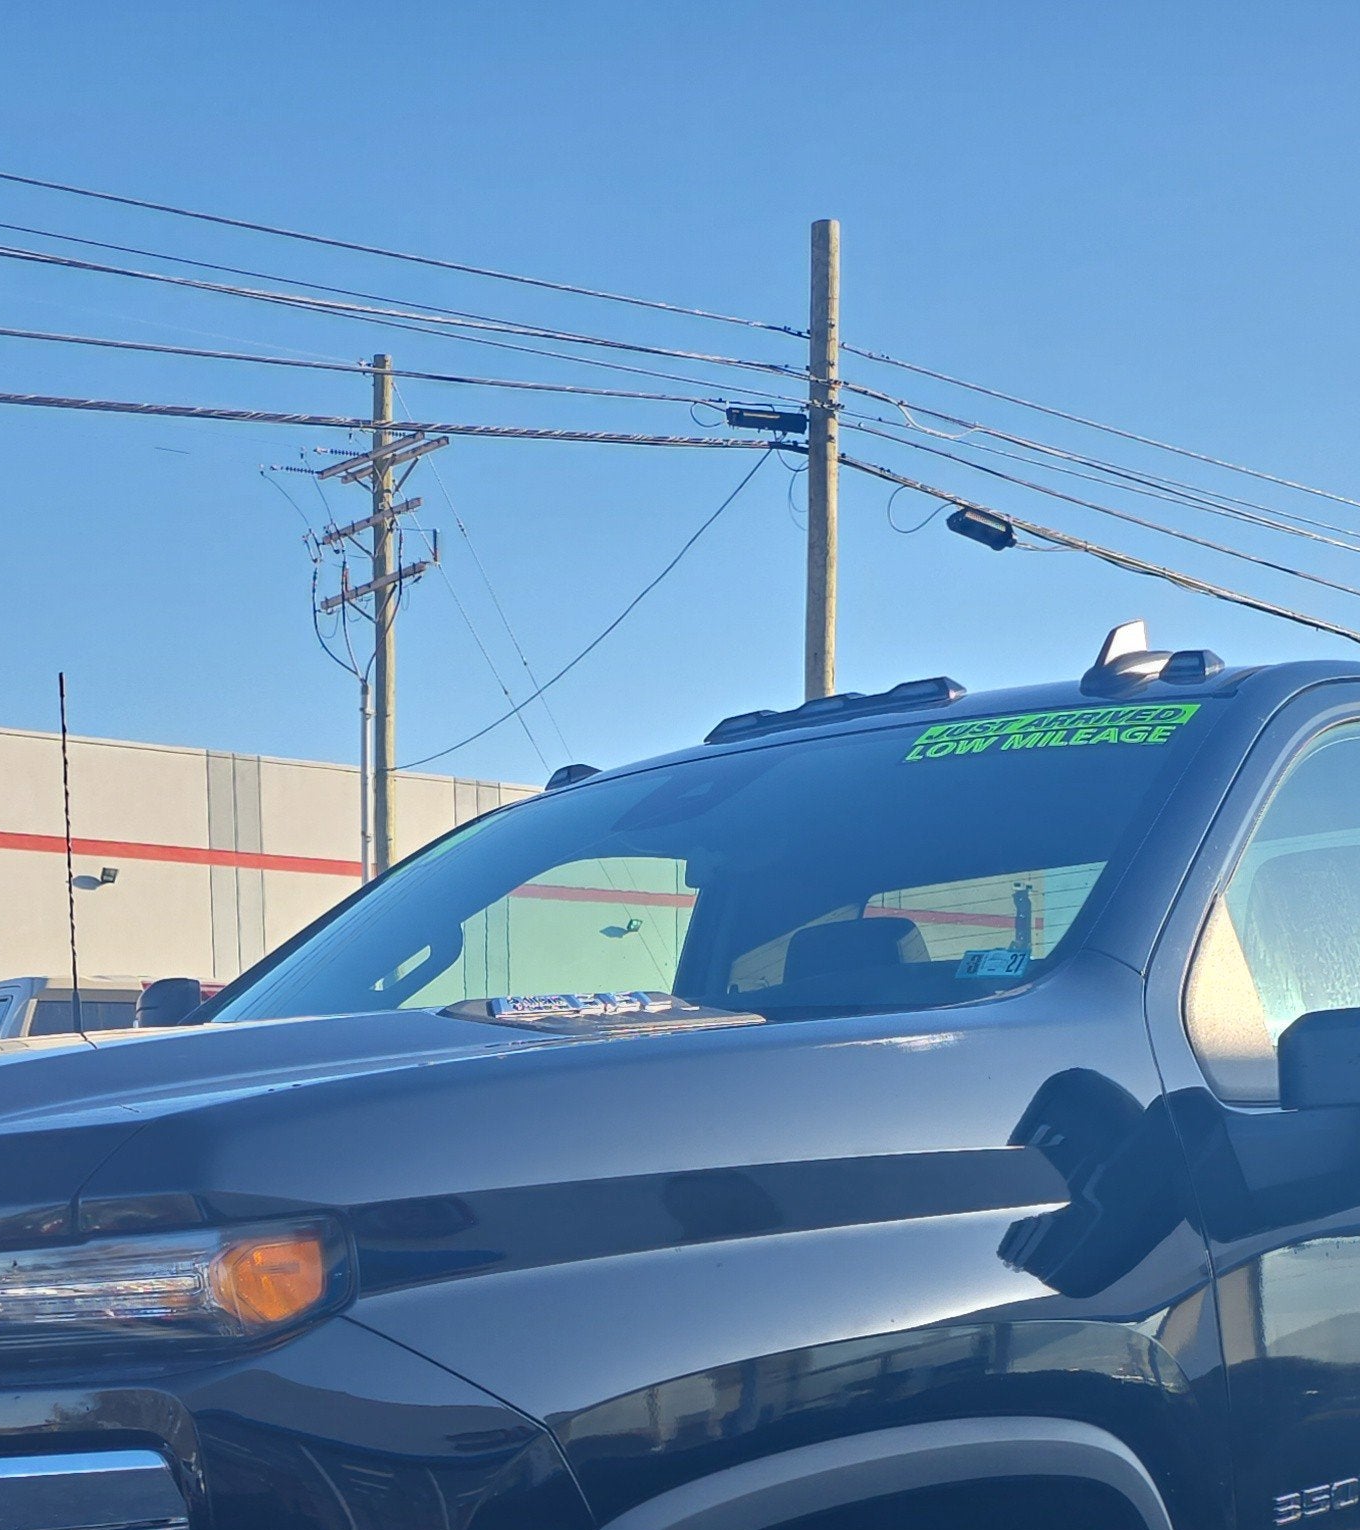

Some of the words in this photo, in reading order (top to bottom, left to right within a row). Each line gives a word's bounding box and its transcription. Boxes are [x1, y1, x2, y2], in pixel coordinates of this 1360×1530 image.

[924, 718, 1024, 740] JUST
[1017, 706, 1187, 731] ARRIVED
[905, 737, 1000, 761] LOW
[1000, 725, 1177, 751] MILEAGE
